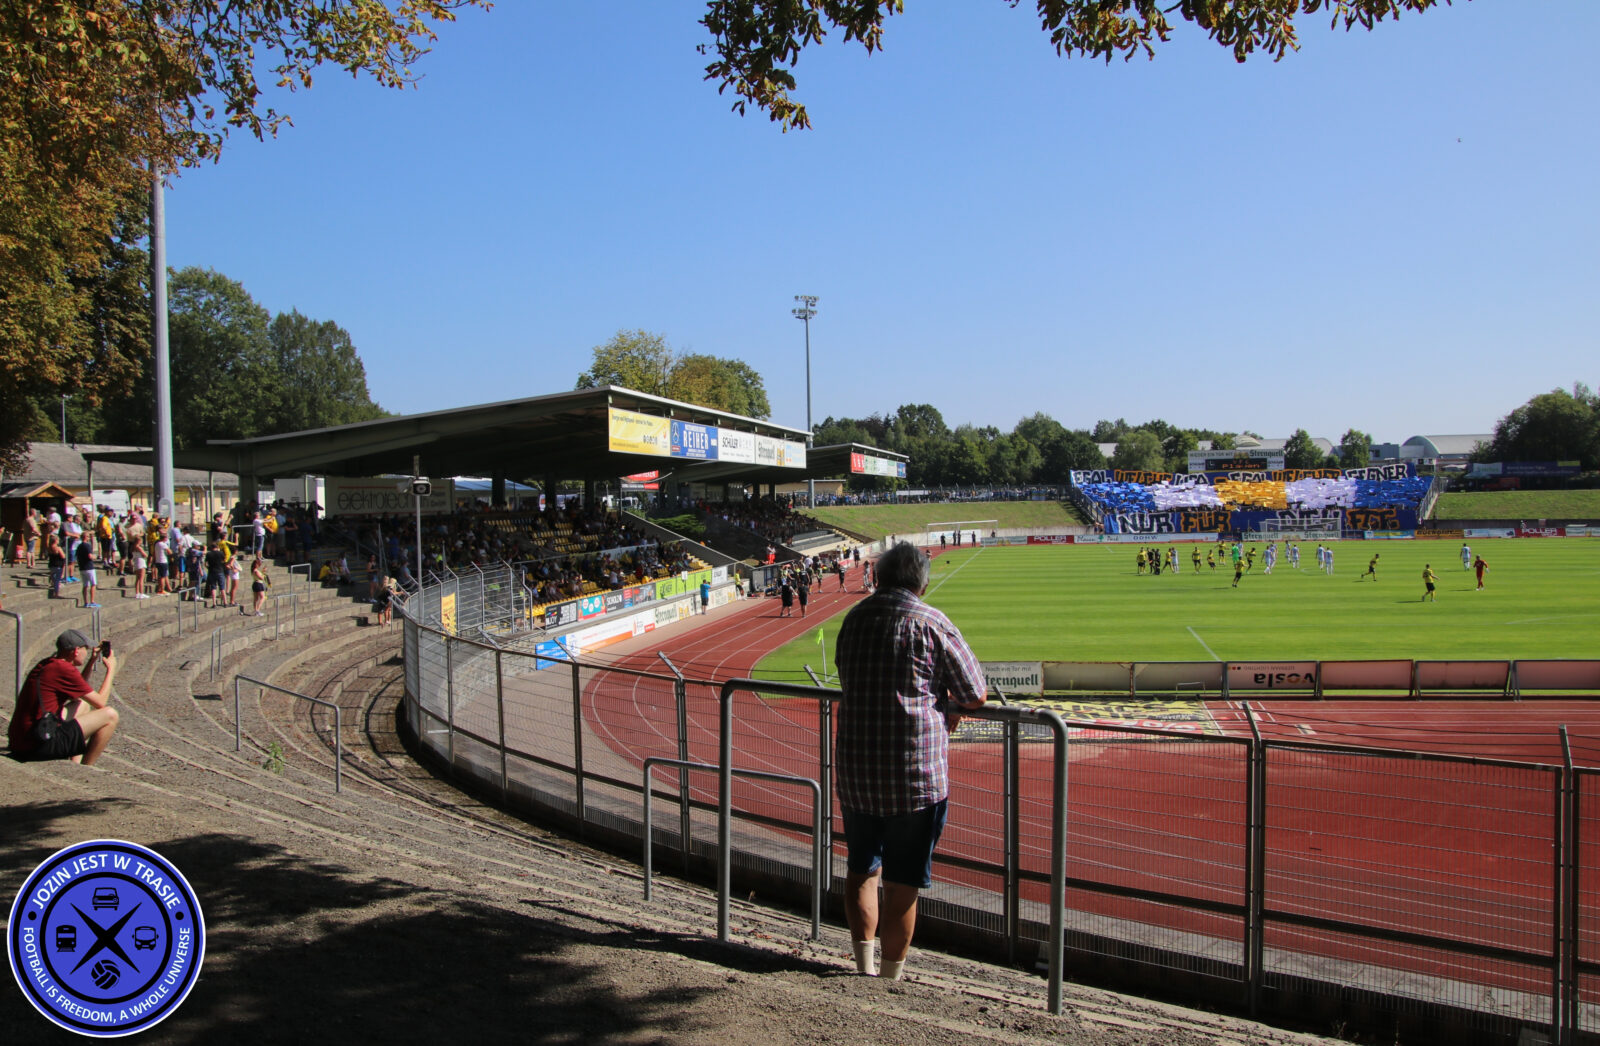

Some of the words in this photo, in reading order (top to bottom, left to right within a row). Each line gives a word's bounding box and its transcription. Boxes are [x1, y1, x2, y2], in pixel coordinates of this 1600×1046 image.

[683, 430, 708, 450] REIHER
[1249, 449, 1283, 457] Sternquell
[1117, 512, 1174, 534] NUR
[983, 674, 1038, 688] ternquell
[1254, 672, 1314, 687] vosla
